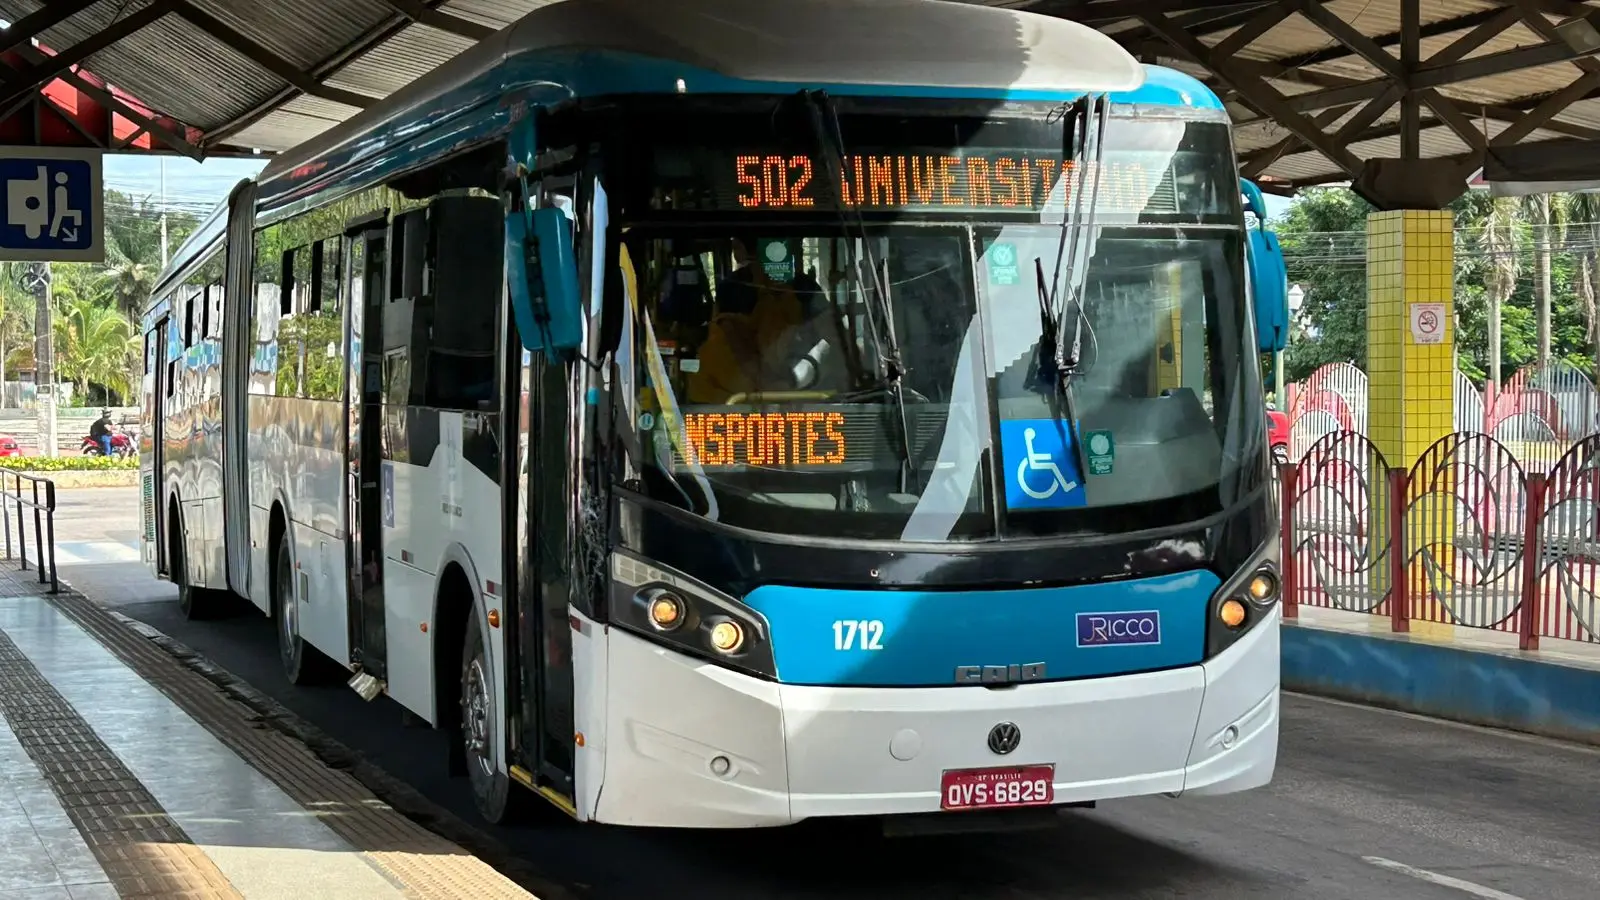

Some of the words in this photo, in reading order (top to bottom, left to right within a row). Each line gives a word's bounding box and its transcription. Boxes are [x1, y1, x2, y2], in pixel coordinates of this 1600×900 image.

[737, 155, 814, 207] 502
[685, 412, 845, 465] NSPORTES
[832, 619, 884, 650] 1712
[1083, 617, 1154, 642] RICCO
